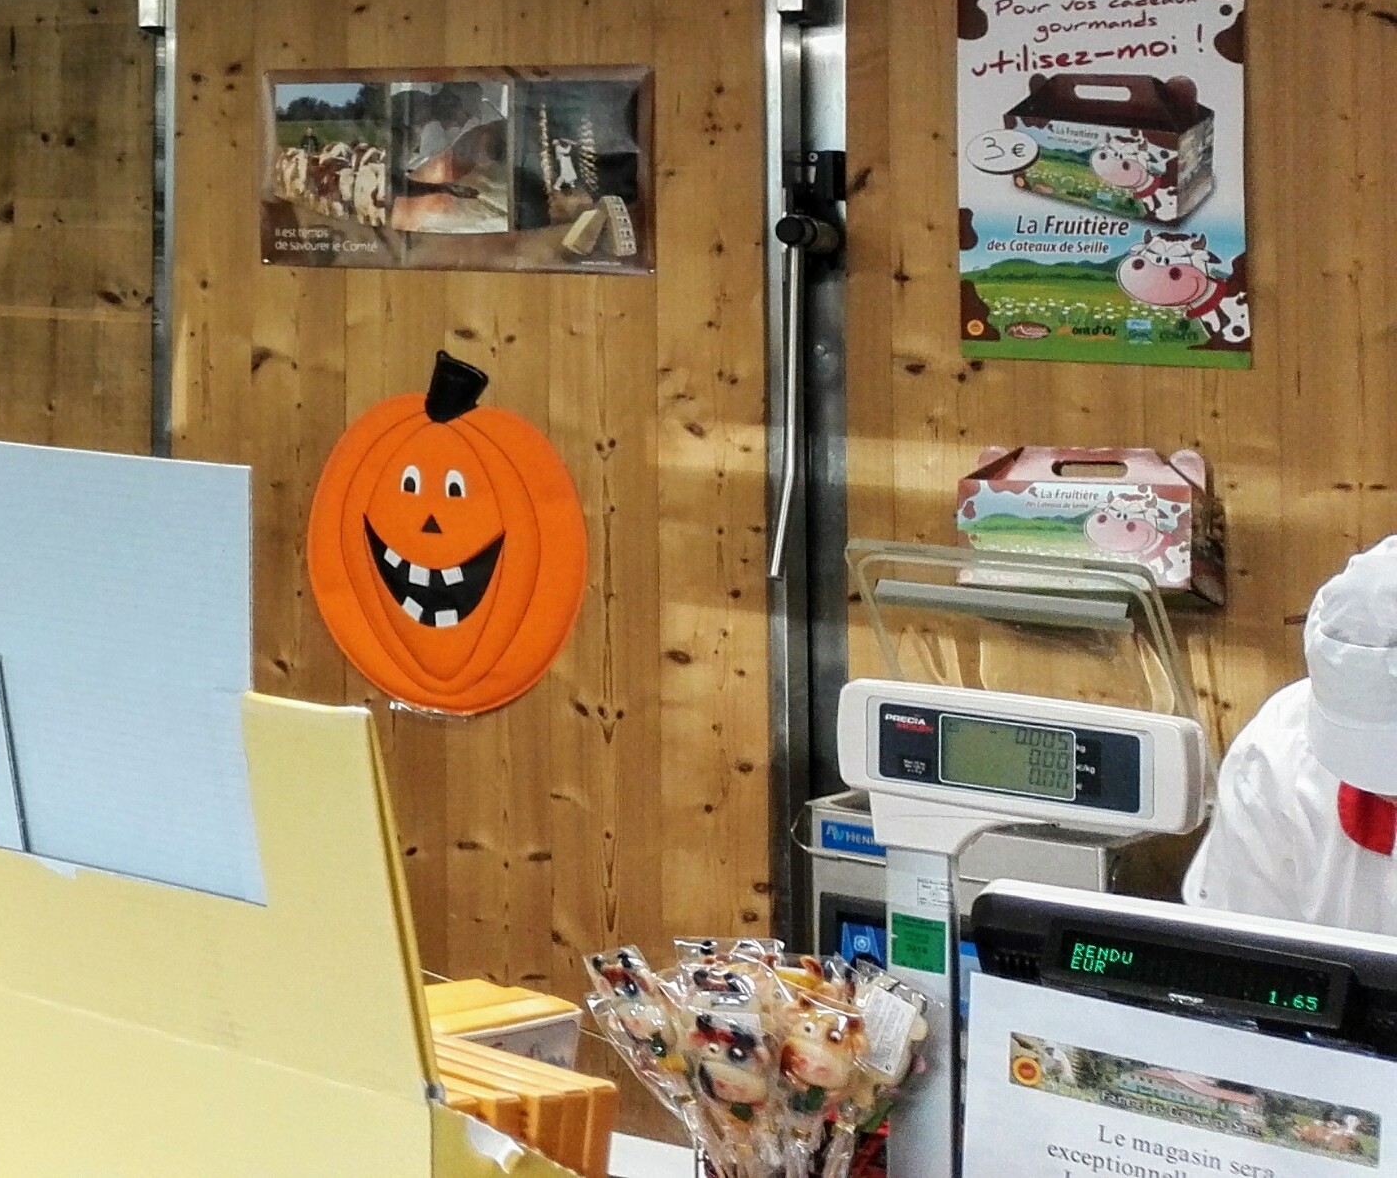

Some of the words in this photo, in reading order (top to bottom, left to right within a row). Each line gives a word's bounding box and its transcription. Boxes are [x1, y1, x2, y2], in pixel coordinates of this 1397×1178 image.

[1061, 0, 1097, 12] vos
[1033, 10, 1158, 42] gourmands
[971, 35, 1178, 76] utilisez-moi
[1196, 23, 1204, 53] !
[982, 136, 1005, 161] 3
[1012, 143, 1026, 158] €
[1016, 215, 1038, 234] La
[1044, 215, 1130, 236] Fruitière
[274, 240, 288, 250] de
[342, 239, 378, 252] Comté
[987, 239, 1006, 251] des
[1009, 239, 1056, 253] Coteaux
[1059, 240, 1075, 253] de
[1077, 241, 1110, 254] Seille
[1040, 488, 1052, 499] La
[1055, 488, 1100, 501] Fruitière
[885, 713, 926, 726] PRECIA
[1072, 941, 1134, 965] RENDU
[1069, 955, 1106, 973] EUR
[1267, 990, 1320, 1012] 1.65
[1098, 1124, 1126, 1147] Le
[1132, 1137, 1222, 1171] magasin
[1229, 1157, 1276, 1178] sera
